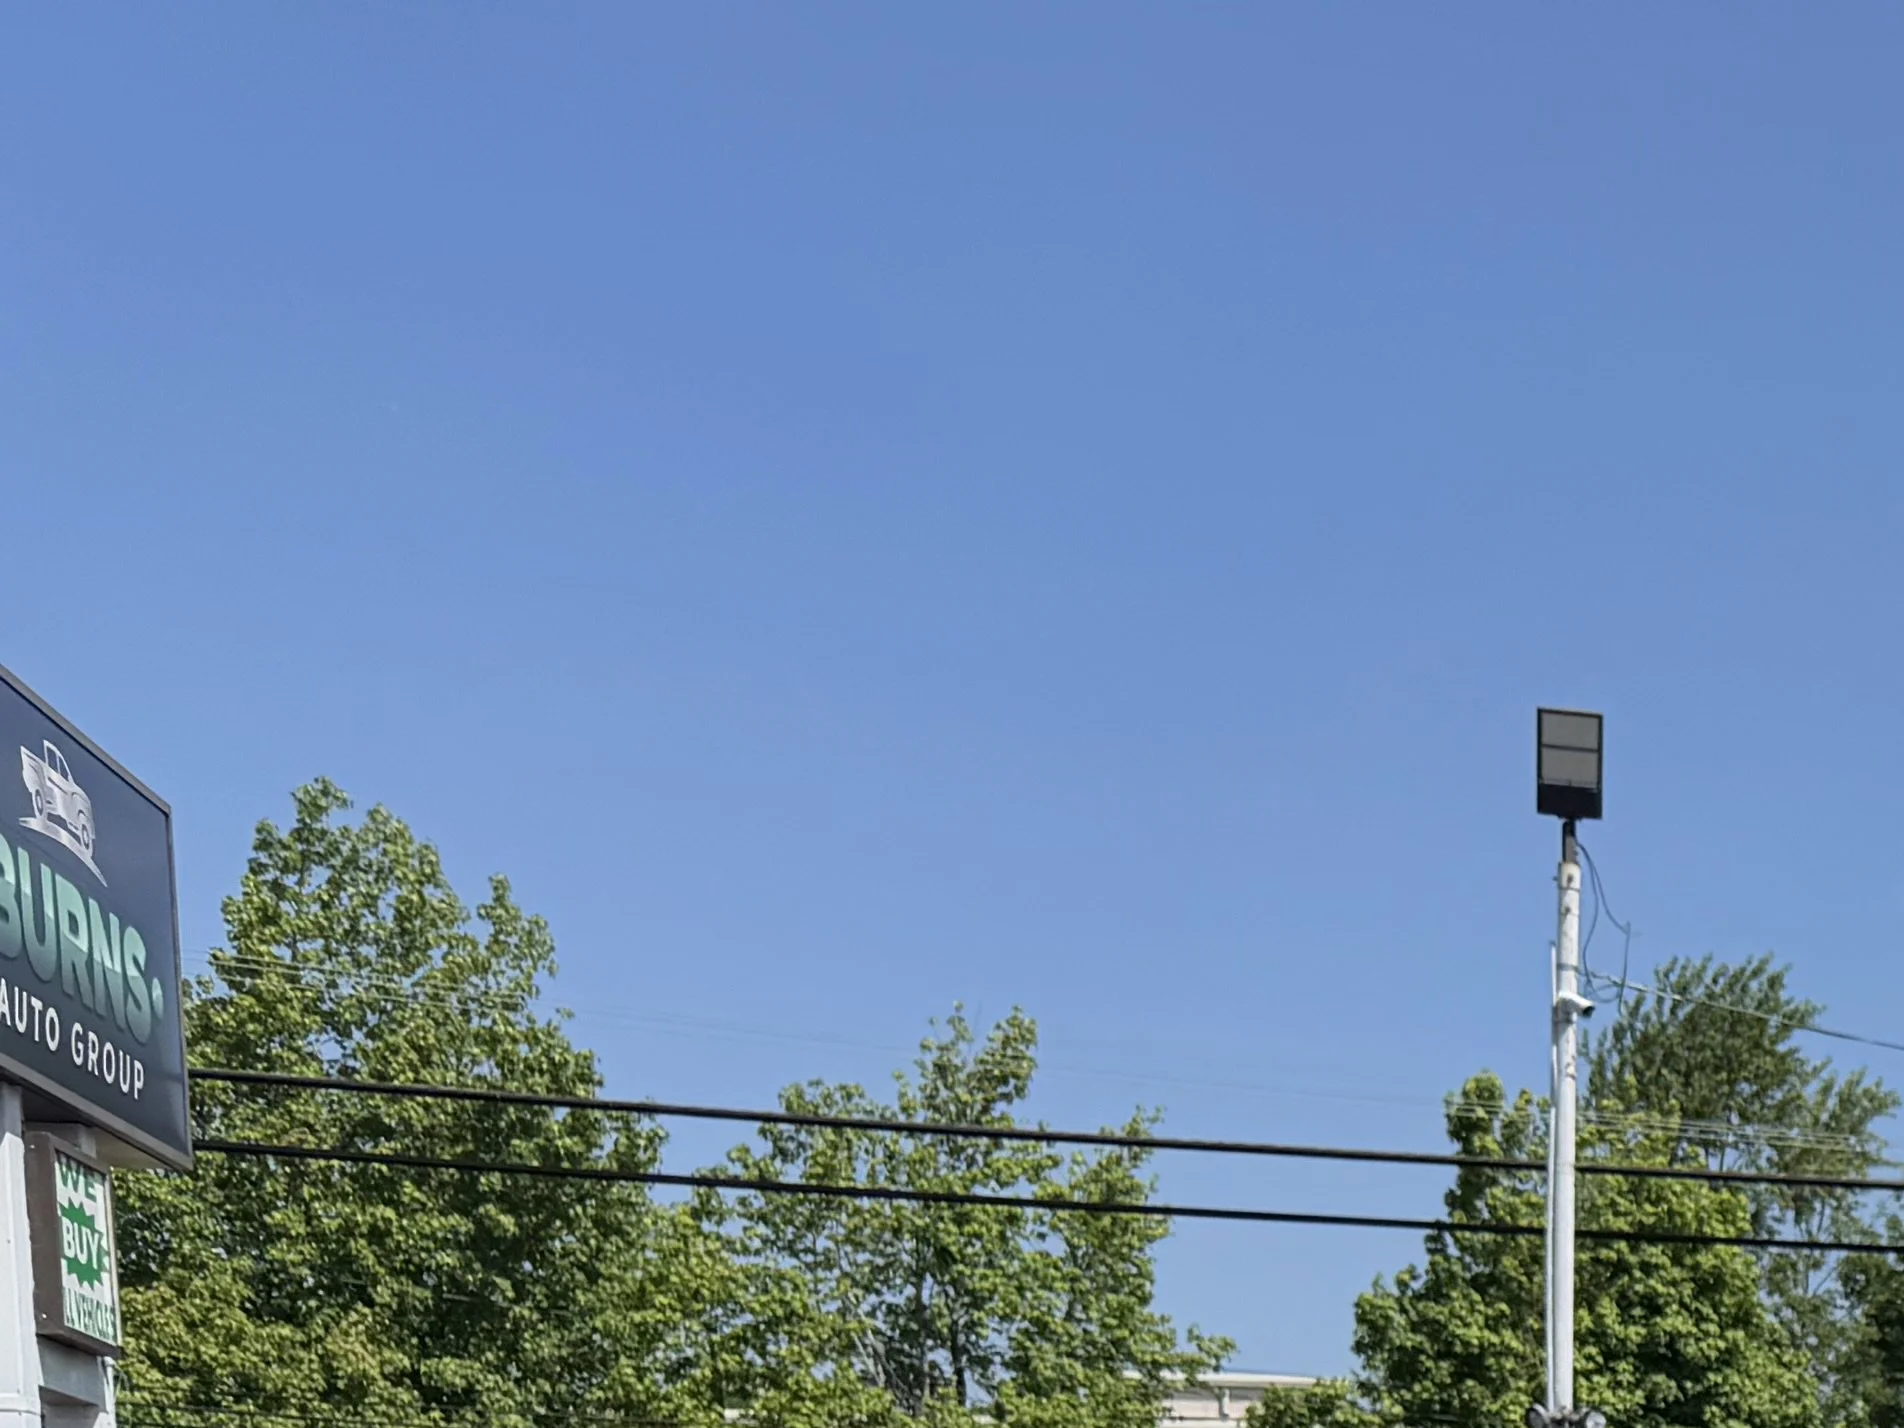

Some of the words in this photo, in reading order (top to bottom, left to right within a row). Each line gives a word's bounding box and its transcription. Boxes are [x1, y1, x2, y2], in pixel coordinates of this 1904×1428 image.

[0, 832, 151, 1044] BURNS
[0, 977, 60, 1051] AUTO
[71, 1021, 145, 1100] GROUP
[56, 1154, 97, 1203] WE
[62, 1216, 99, 1270] BUY
